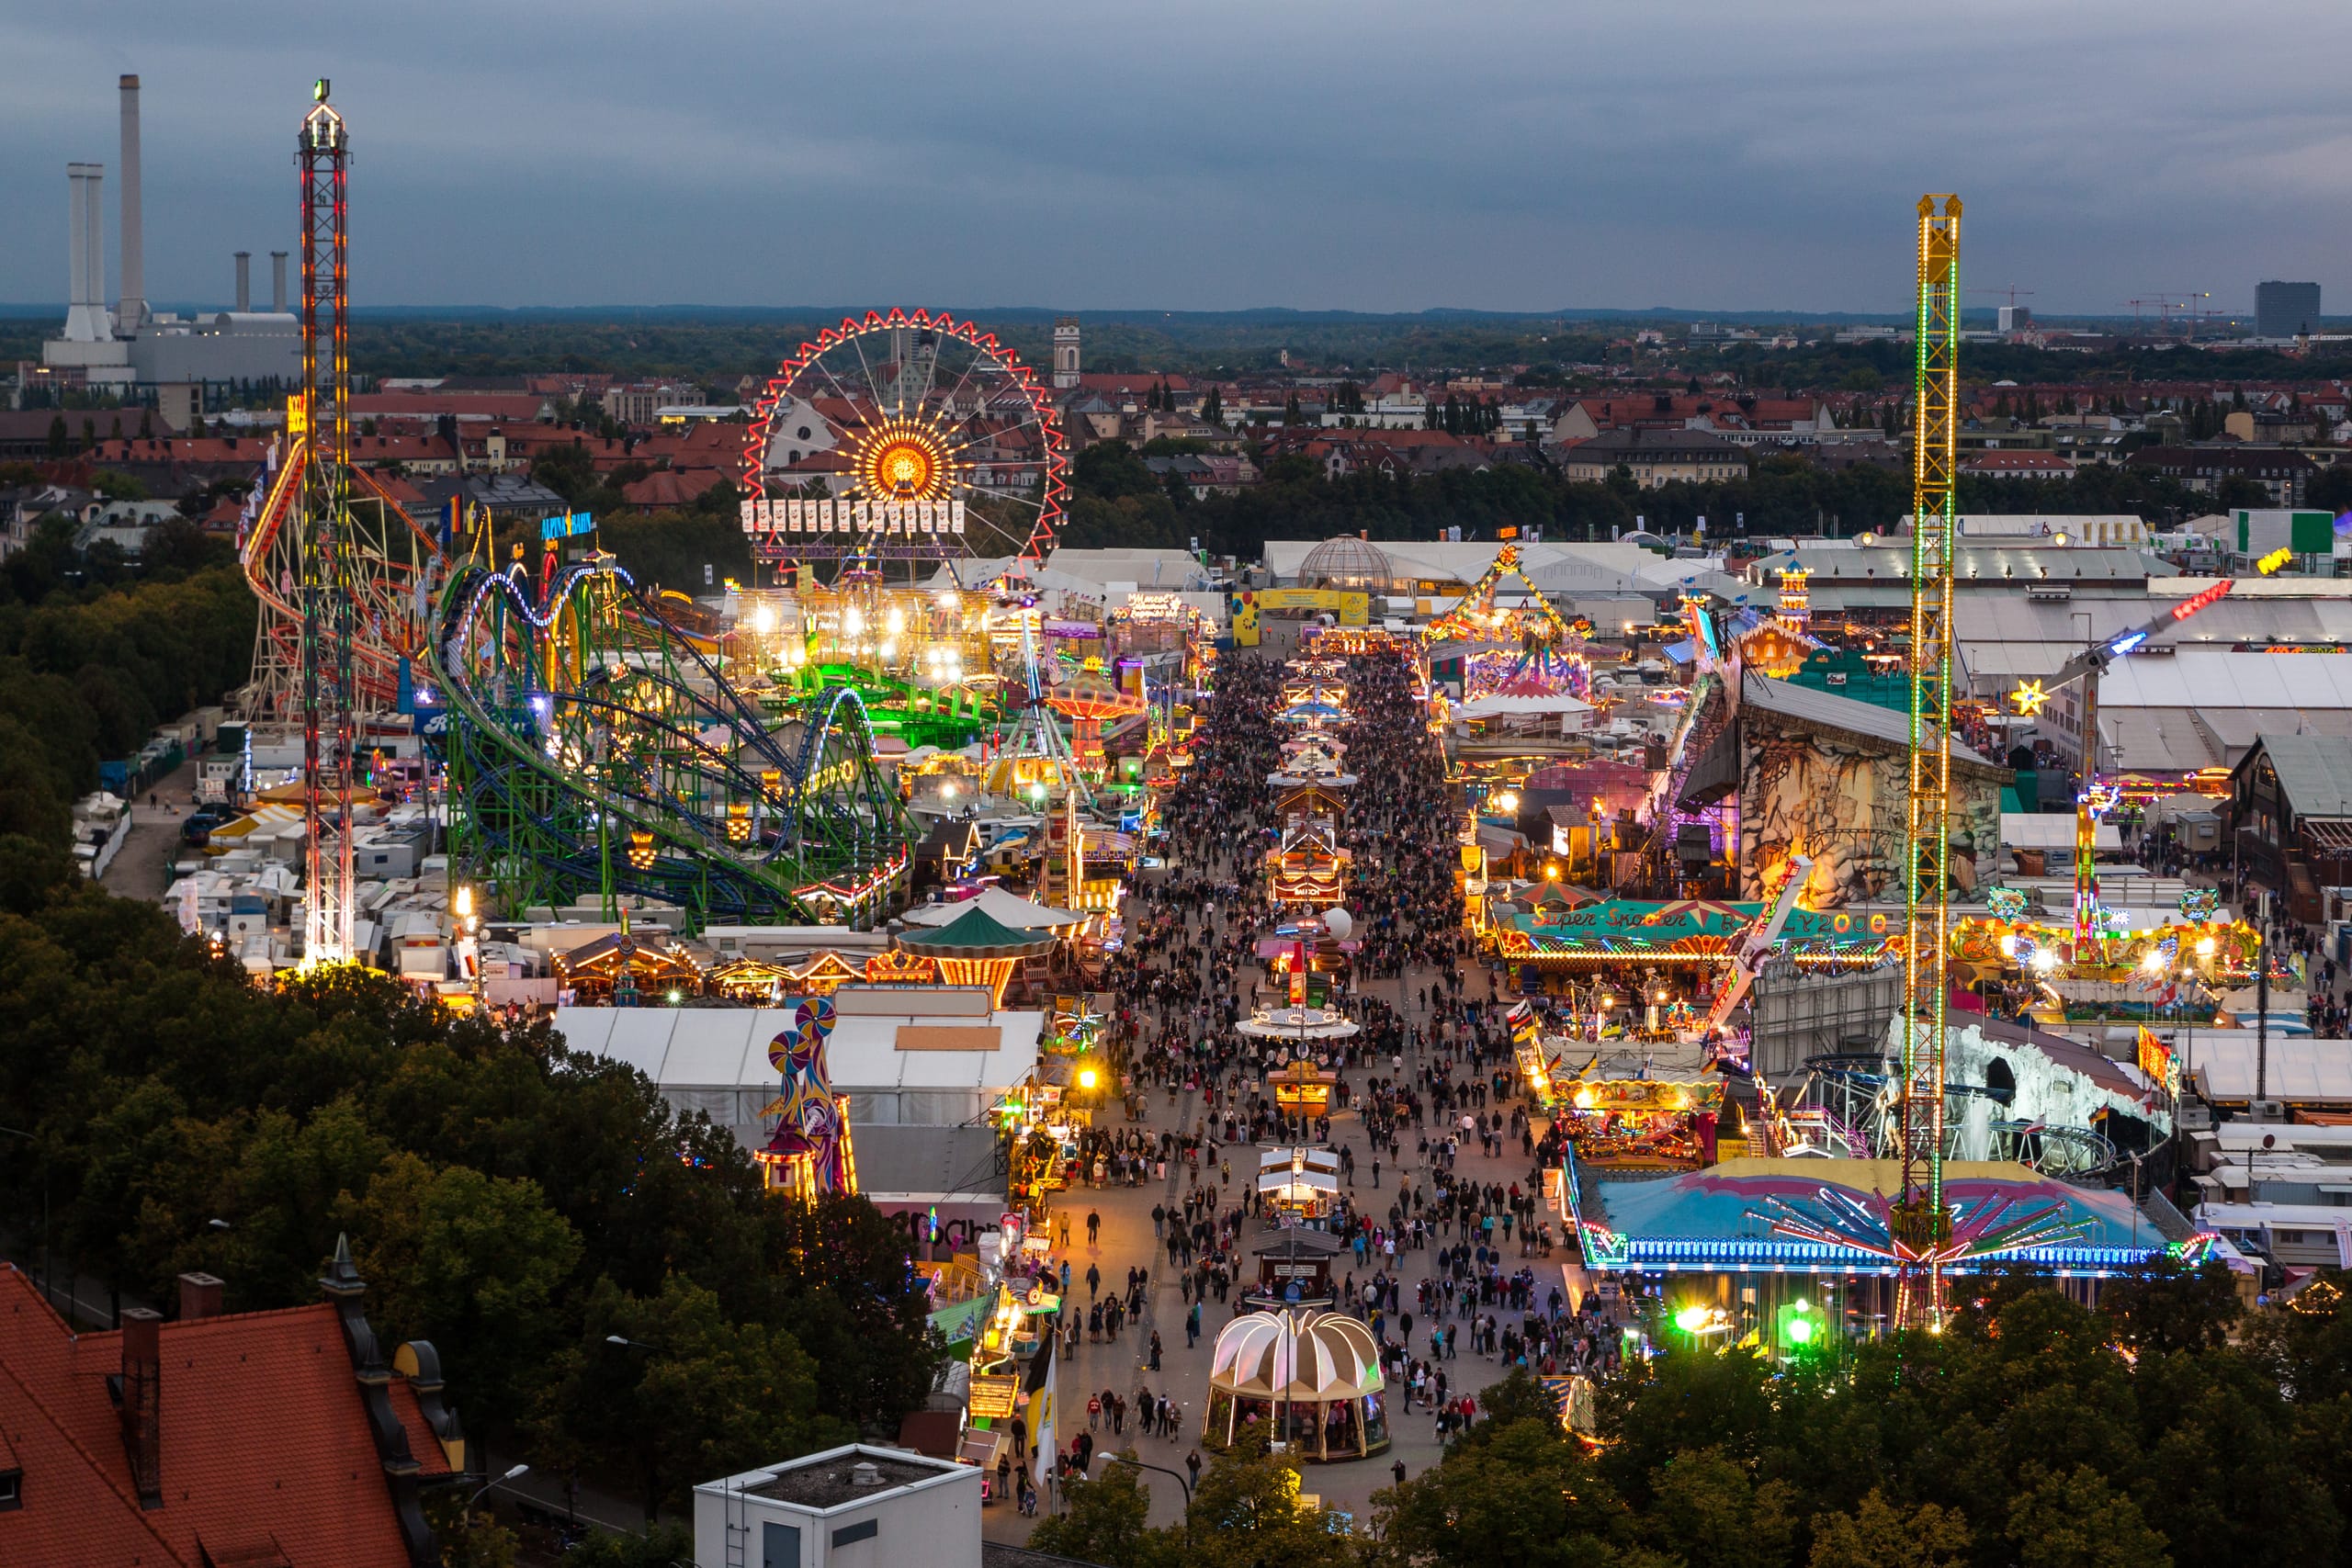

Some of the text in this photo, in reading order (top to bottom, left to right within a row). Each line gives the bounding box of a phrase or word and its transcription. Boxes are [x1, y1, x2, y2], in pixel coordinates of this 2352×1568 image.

[540, 512, 591, 540] ALPINA BAHN
[1721, 913, 1815, 932] RLY
